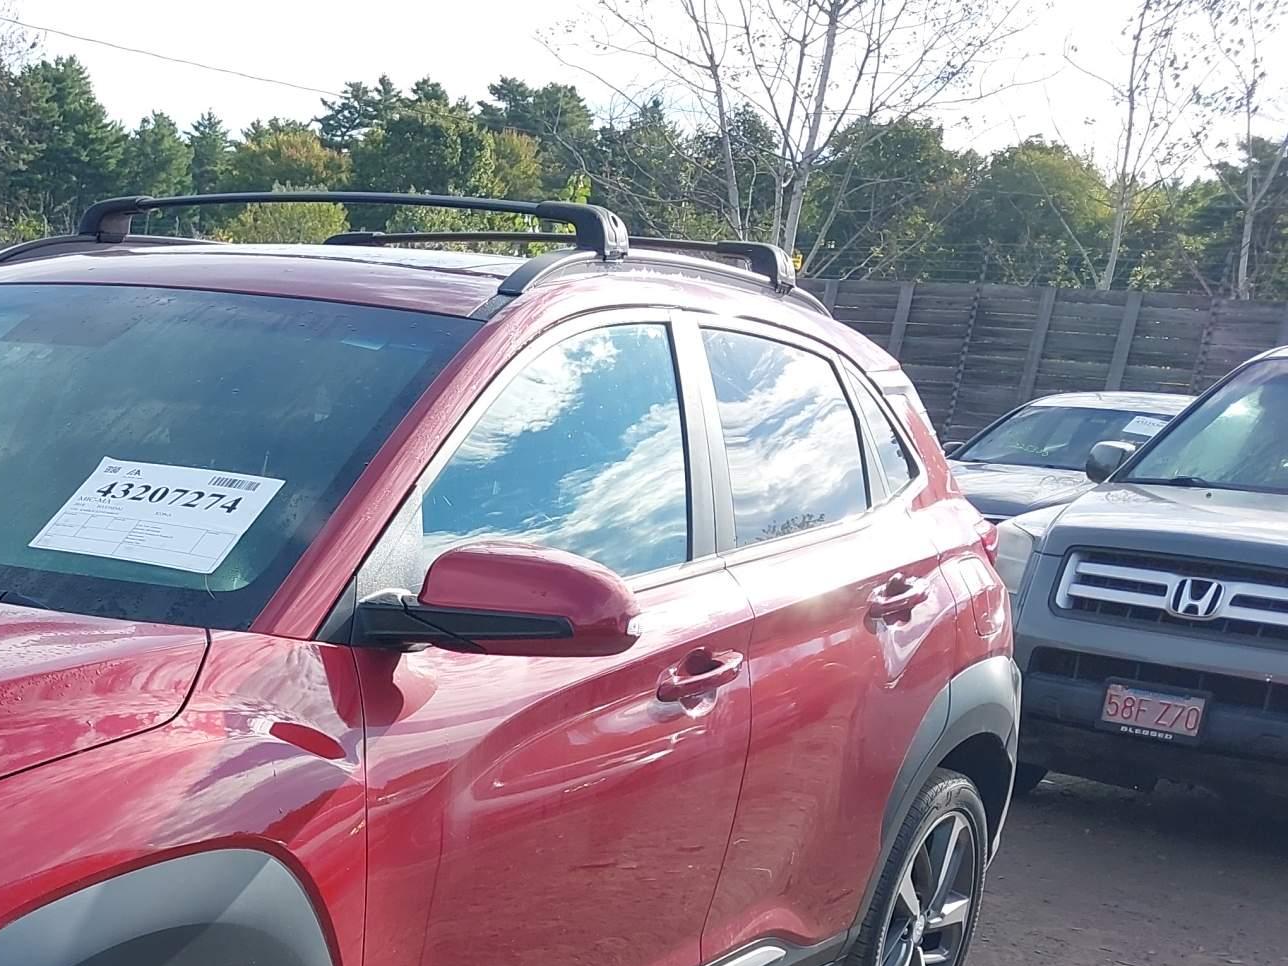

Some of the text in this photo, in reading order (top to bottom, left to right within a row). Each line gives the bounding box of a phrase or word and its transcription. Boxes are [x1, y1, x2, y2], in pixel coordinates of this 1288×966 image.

[96, 482, 243, 514] 43207274
[1106, 694, 1201, 731] 58F Z70
